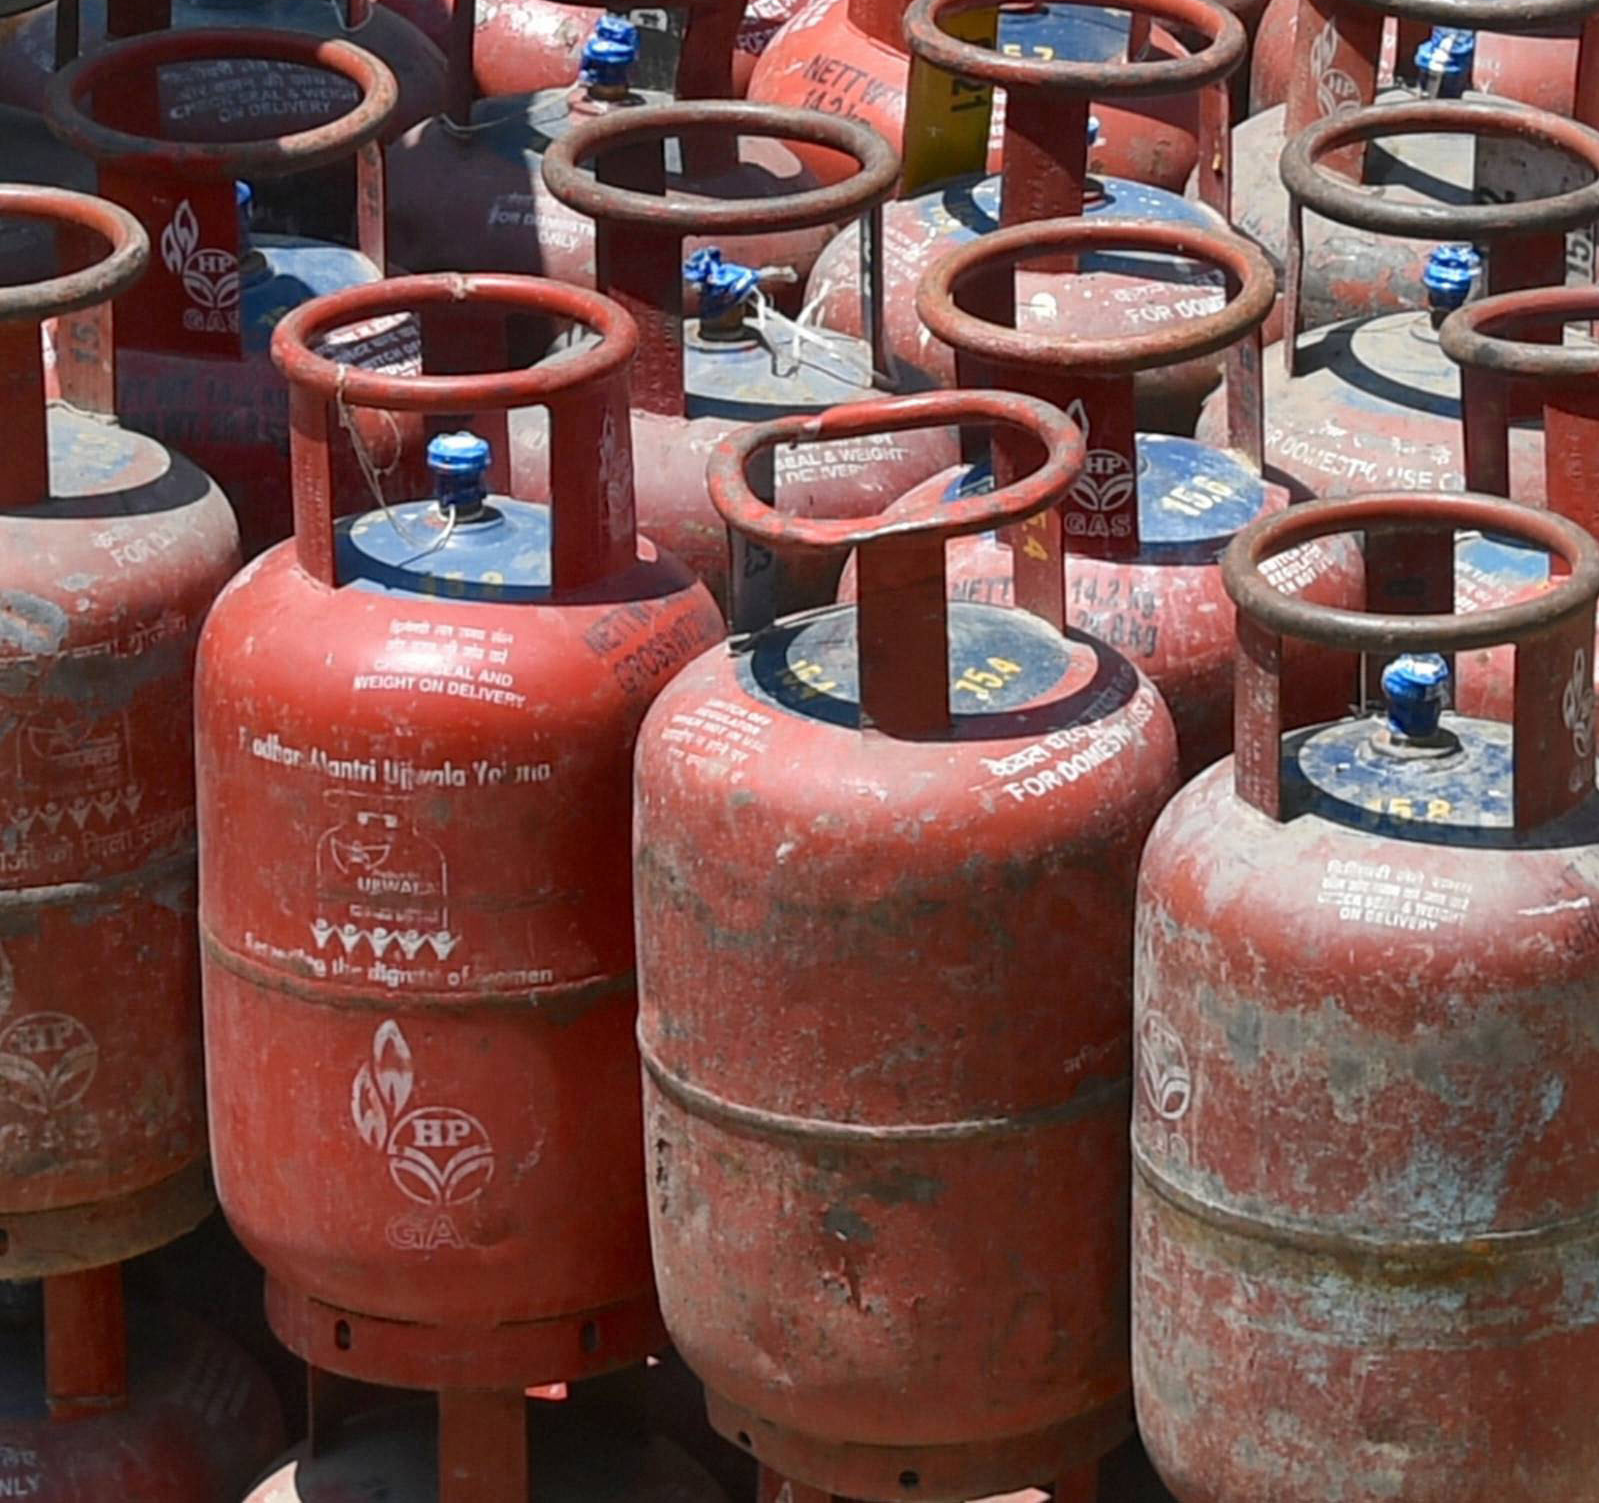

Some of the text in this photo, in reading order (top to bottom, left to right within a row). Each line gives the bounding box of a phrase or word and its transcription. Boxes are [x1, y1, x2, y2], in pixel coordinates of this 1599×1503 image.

[803, 55, 863, 87] NETT
[251, 99, 332, 119] DELIVERY
[199, 256, 231, 273] HP
[1125, 304, 1174, 326] FOR
[840, 445, 907, 463] WEIGHT
[1084, 456, 1121, 477] HP
[1063, 513, 1132, 538] GAS
[353, 671, 416, 690] WEIGHT
[418, 677, 444, 694] ON
[479, 668, 513, 687] AND
[955, 654, 1022, 701] 15.4
[1004, 763, 1064, 802] FOR
[1339, 906, 1361, 921] ON
[412, 1119, 471, 1148] HP
